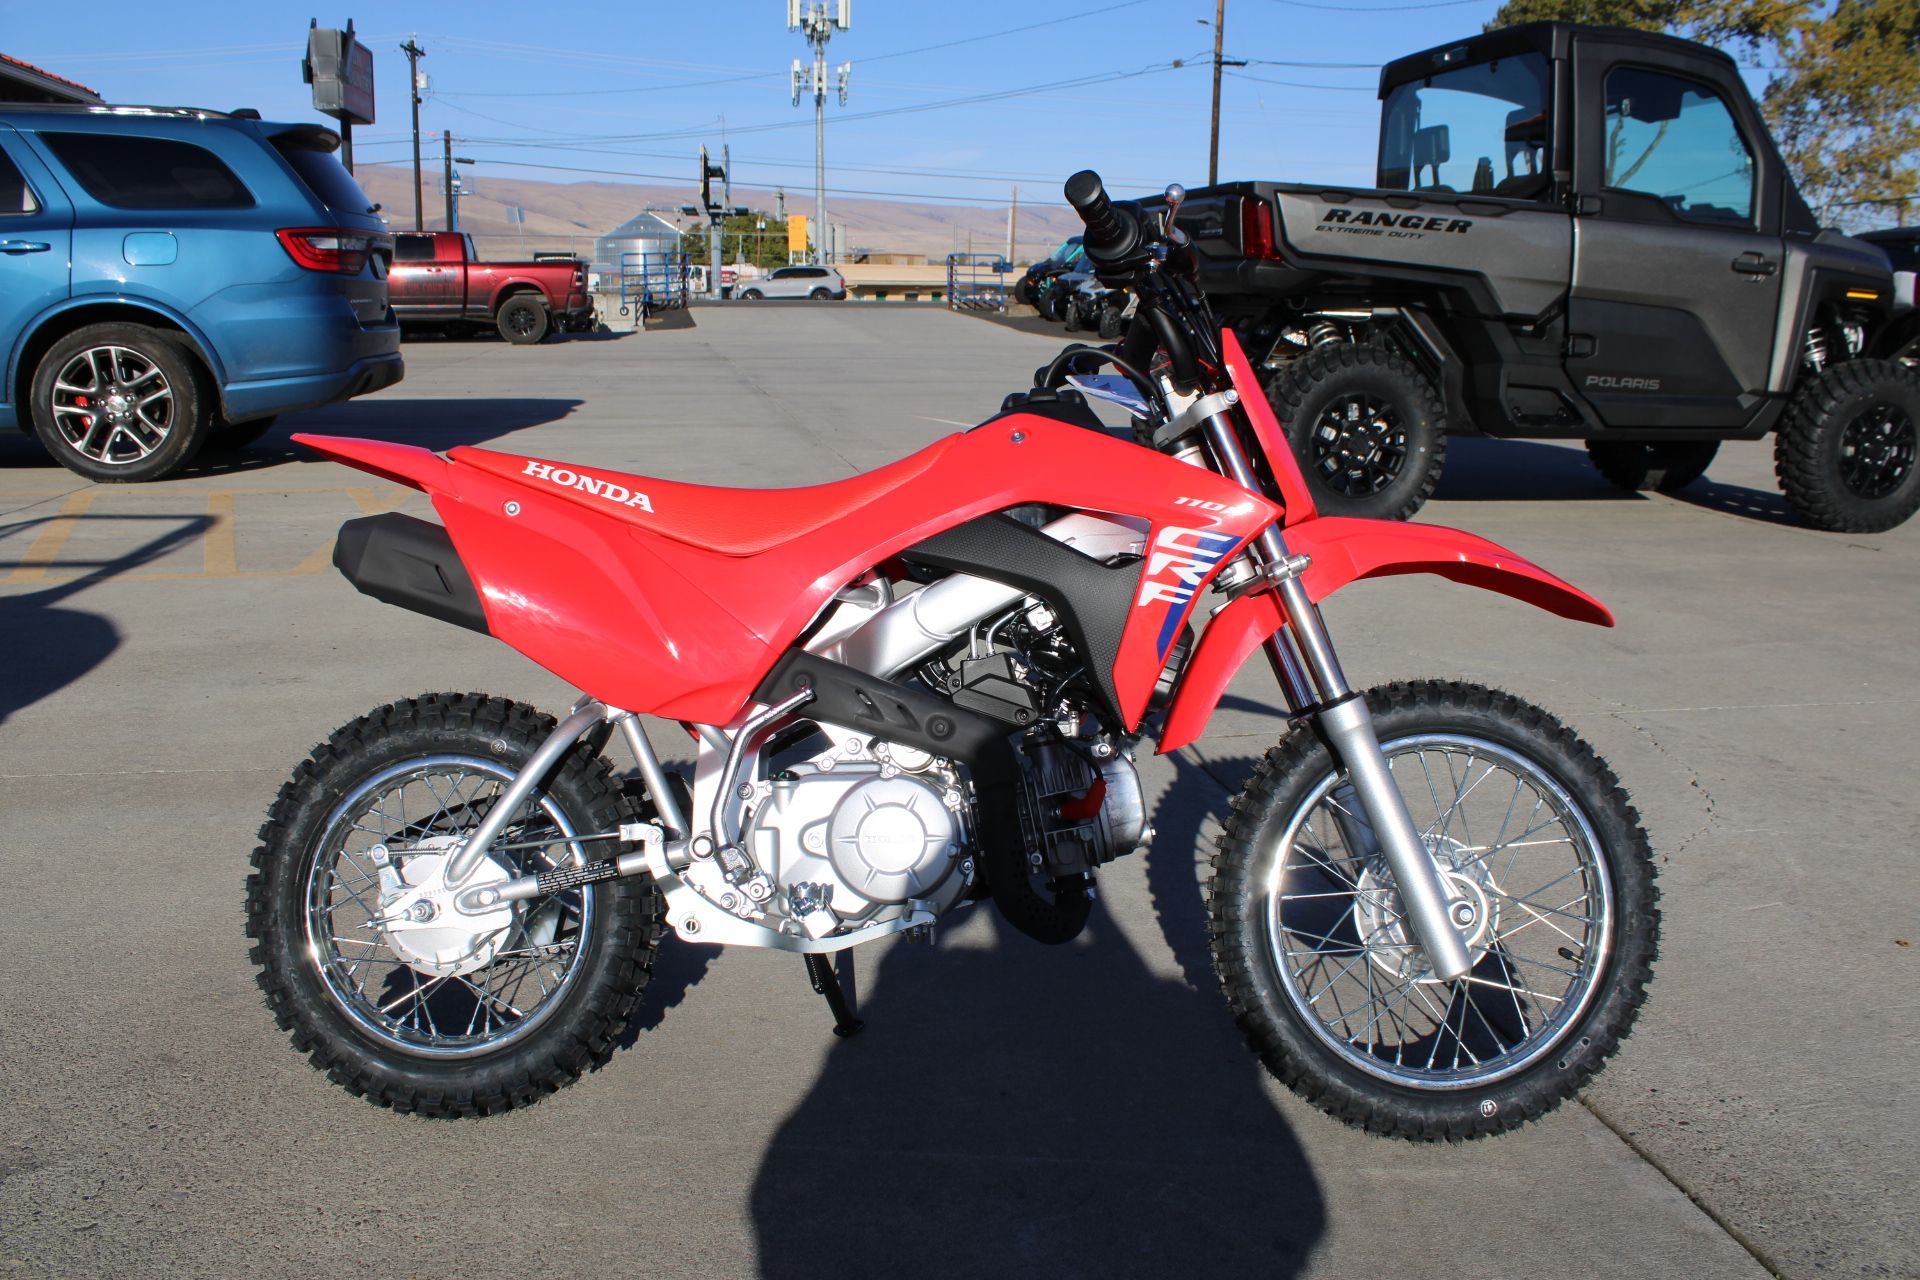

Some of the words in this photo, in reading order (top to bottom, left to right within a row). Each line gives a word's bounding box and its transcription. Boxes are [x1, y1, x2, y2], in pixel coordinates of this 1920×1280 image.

[1315, 225, 1384, 236] EXTREME
[1388, 231, 1427, 240] DUTY
[1323, 208, 1473, 234] RANGER
[1585, 375, 1661, 390] POLARIS
[521, 460, 655, 513] HONDA
[1138, 525, 1233, 607] CRF
